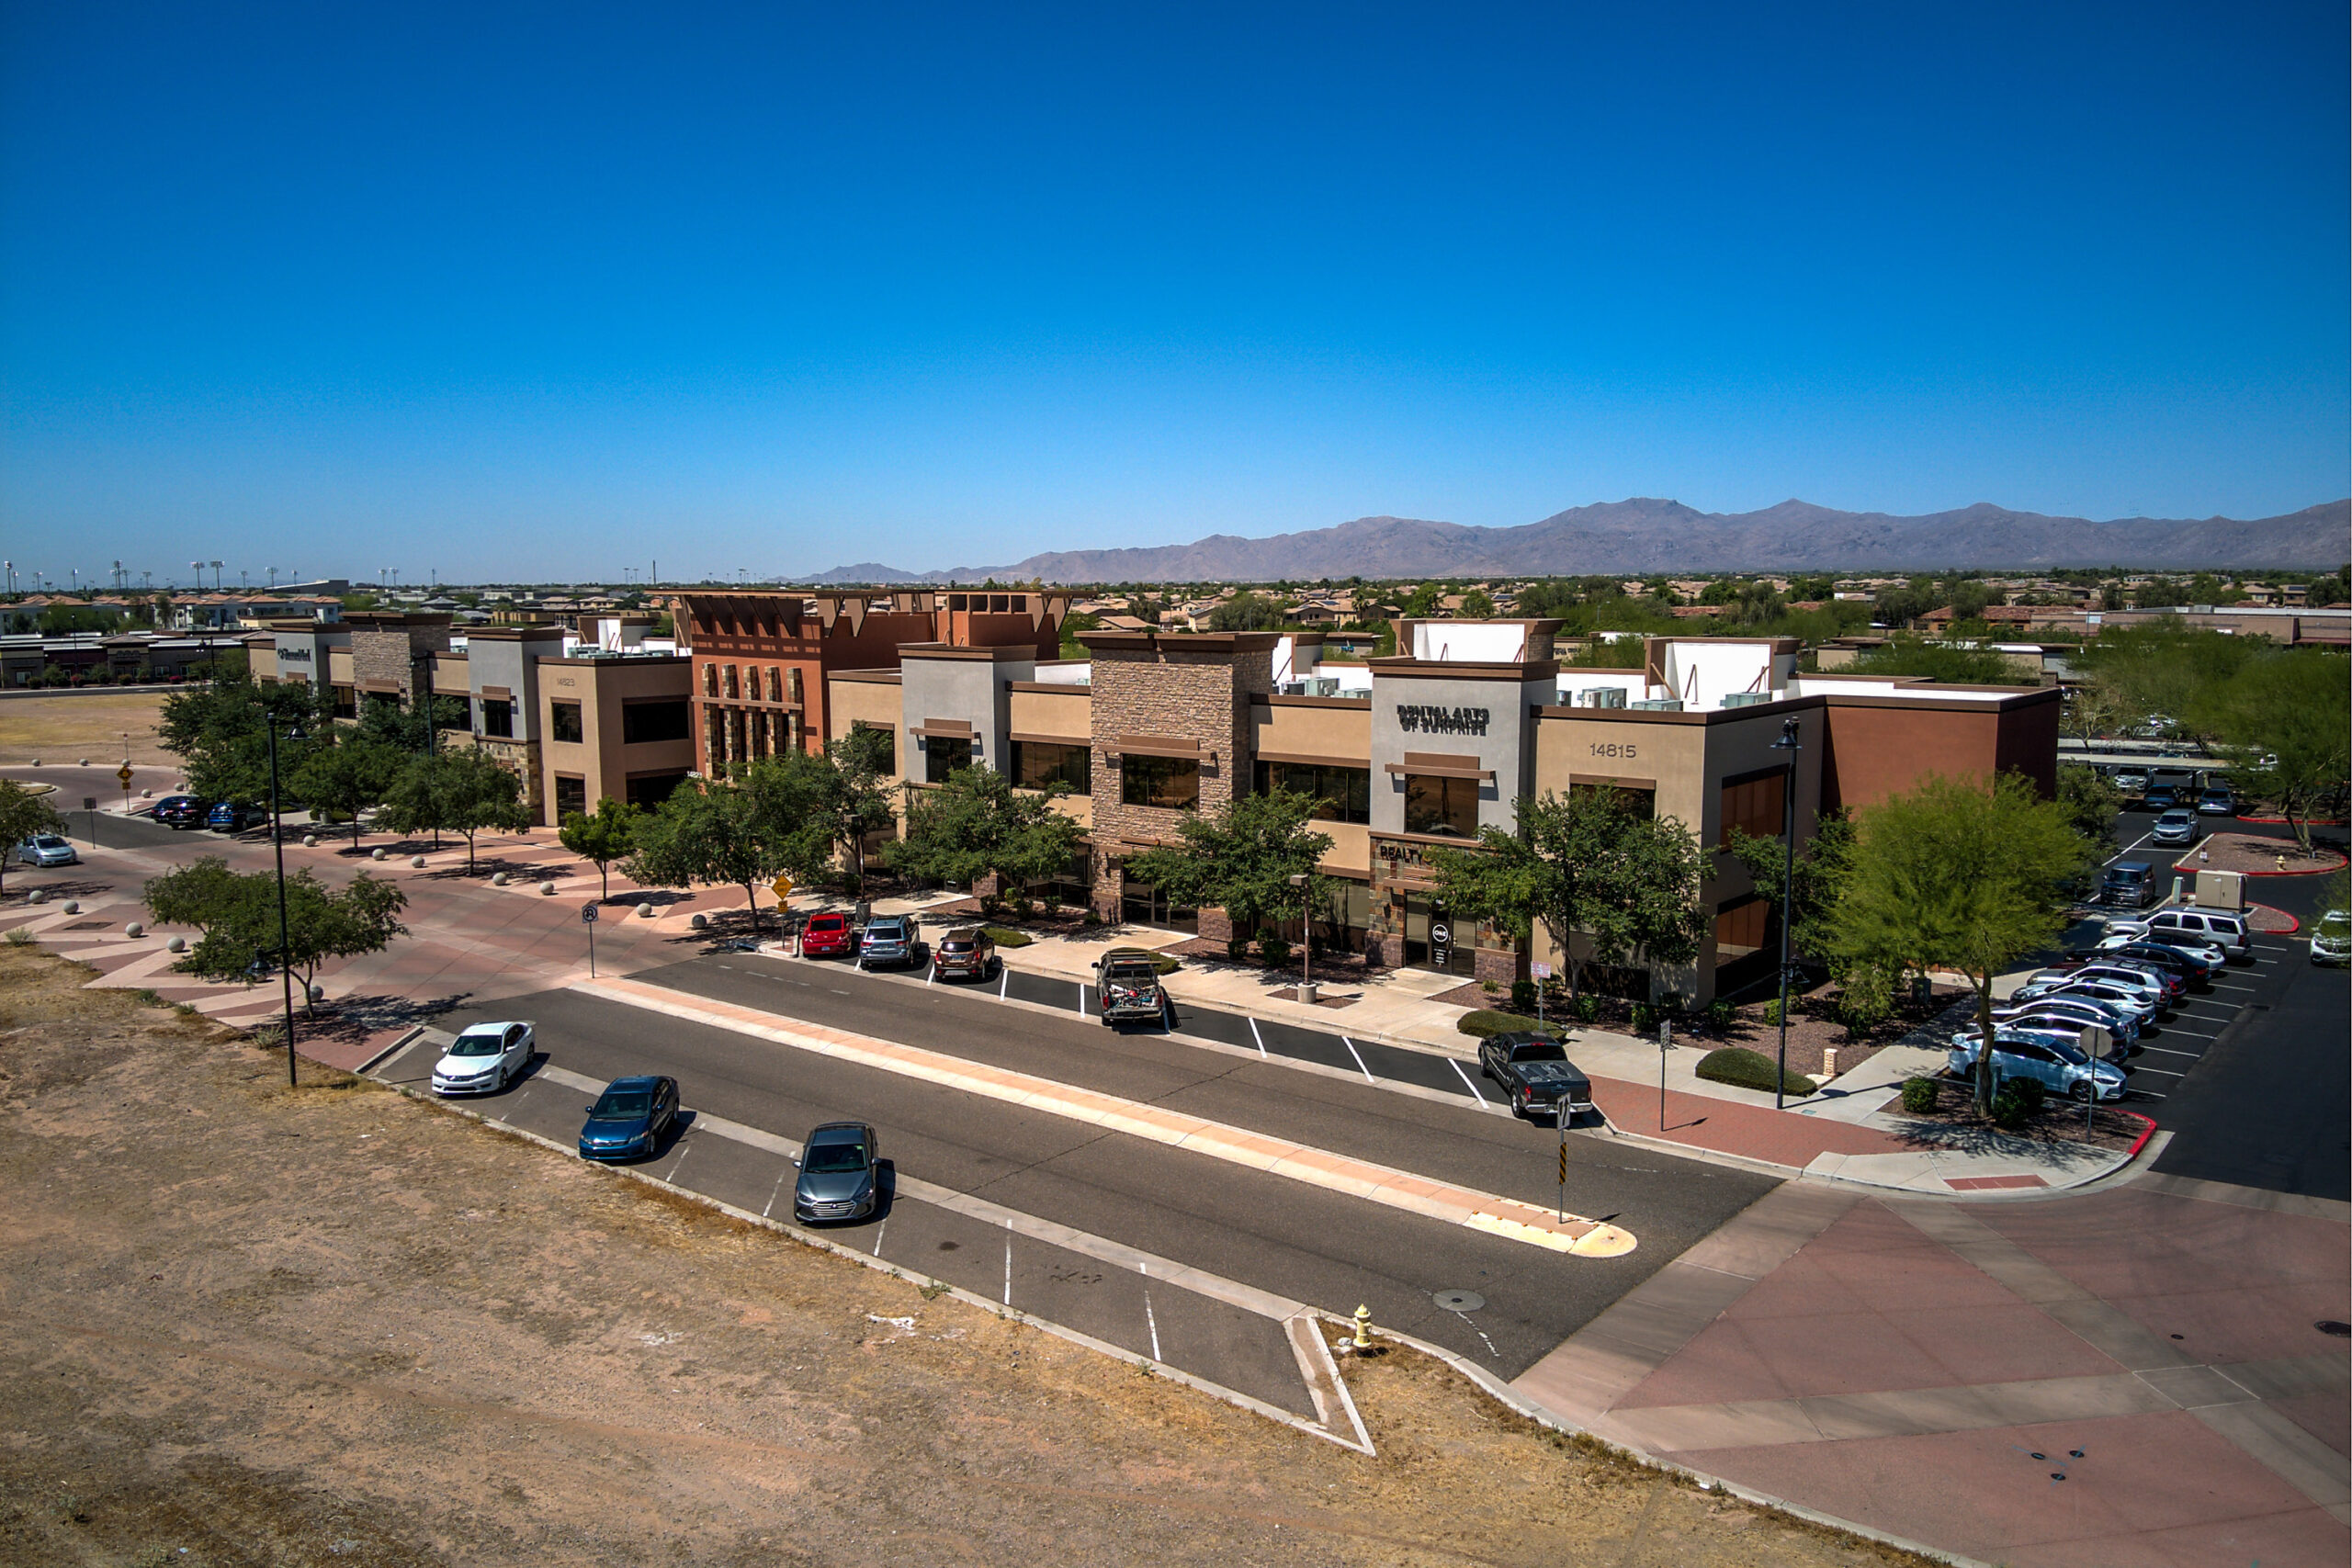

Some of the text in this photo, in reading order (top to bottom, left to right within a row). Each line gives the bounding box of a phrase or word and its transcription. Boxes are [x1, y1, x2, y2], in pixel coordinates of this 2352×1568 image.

[1396, 704, 1490, 720] DENTAL ARTS
[1420, 716, 1487, 735] SURPRISE
[1589, 742, 1637, 759] 14815
[1380, 845, 1422, 864] REALTY
